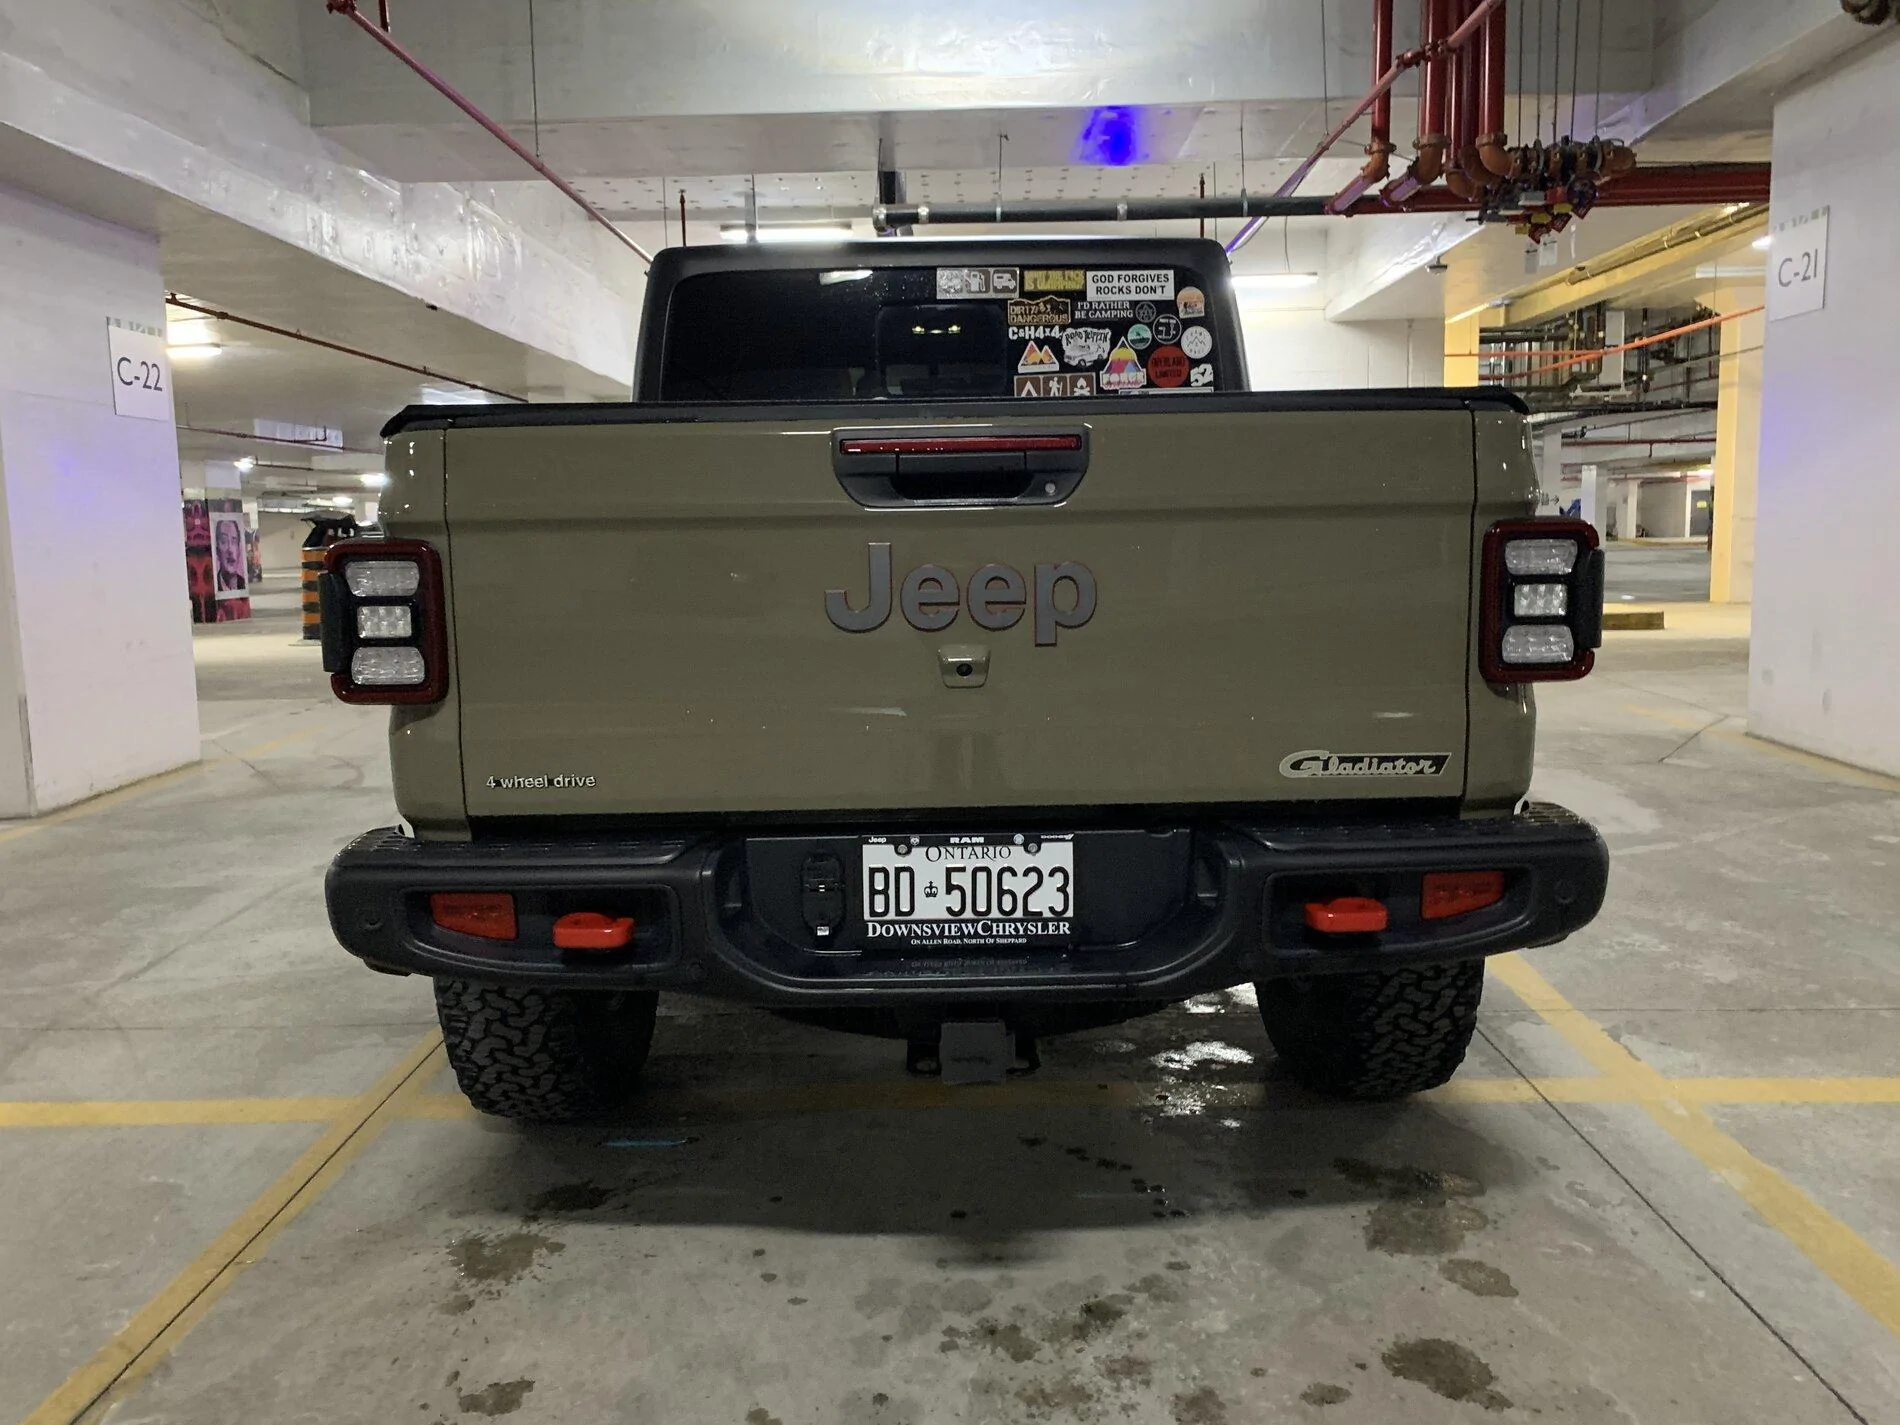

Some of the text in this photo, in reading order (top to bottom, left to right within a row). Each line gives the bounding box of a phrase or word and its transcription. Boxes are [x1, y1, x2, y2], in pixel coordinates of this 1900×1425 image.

[1778, 248, 1818, 288] C-21
[1092, 273, 1170, 283] GOD FORGIVES
[1096, 285, 1166, 295] ROCKS DON'T
[1077, 301, 1130, 310] I'D RATHER
[1011, 314, 1069, 323] DANGEROUS
[1074, 310, 1134, 319] BE CAMPING
[1065, 331, 1084, 346] ROAD
[117, 356, 163, 392] C-22
[824, 542, 1098, 648] Jeep
[1278, 749, 1437, 779] Gladiator
[486, 773, 597, 789] 4 wheel drive
[868, 836, 887, 844] Jeep
[949, 836, 985, 844] RAM
[925, 845, 1011, 862] ONTARIO
[868, 865, 1070, 918] BD 50623
